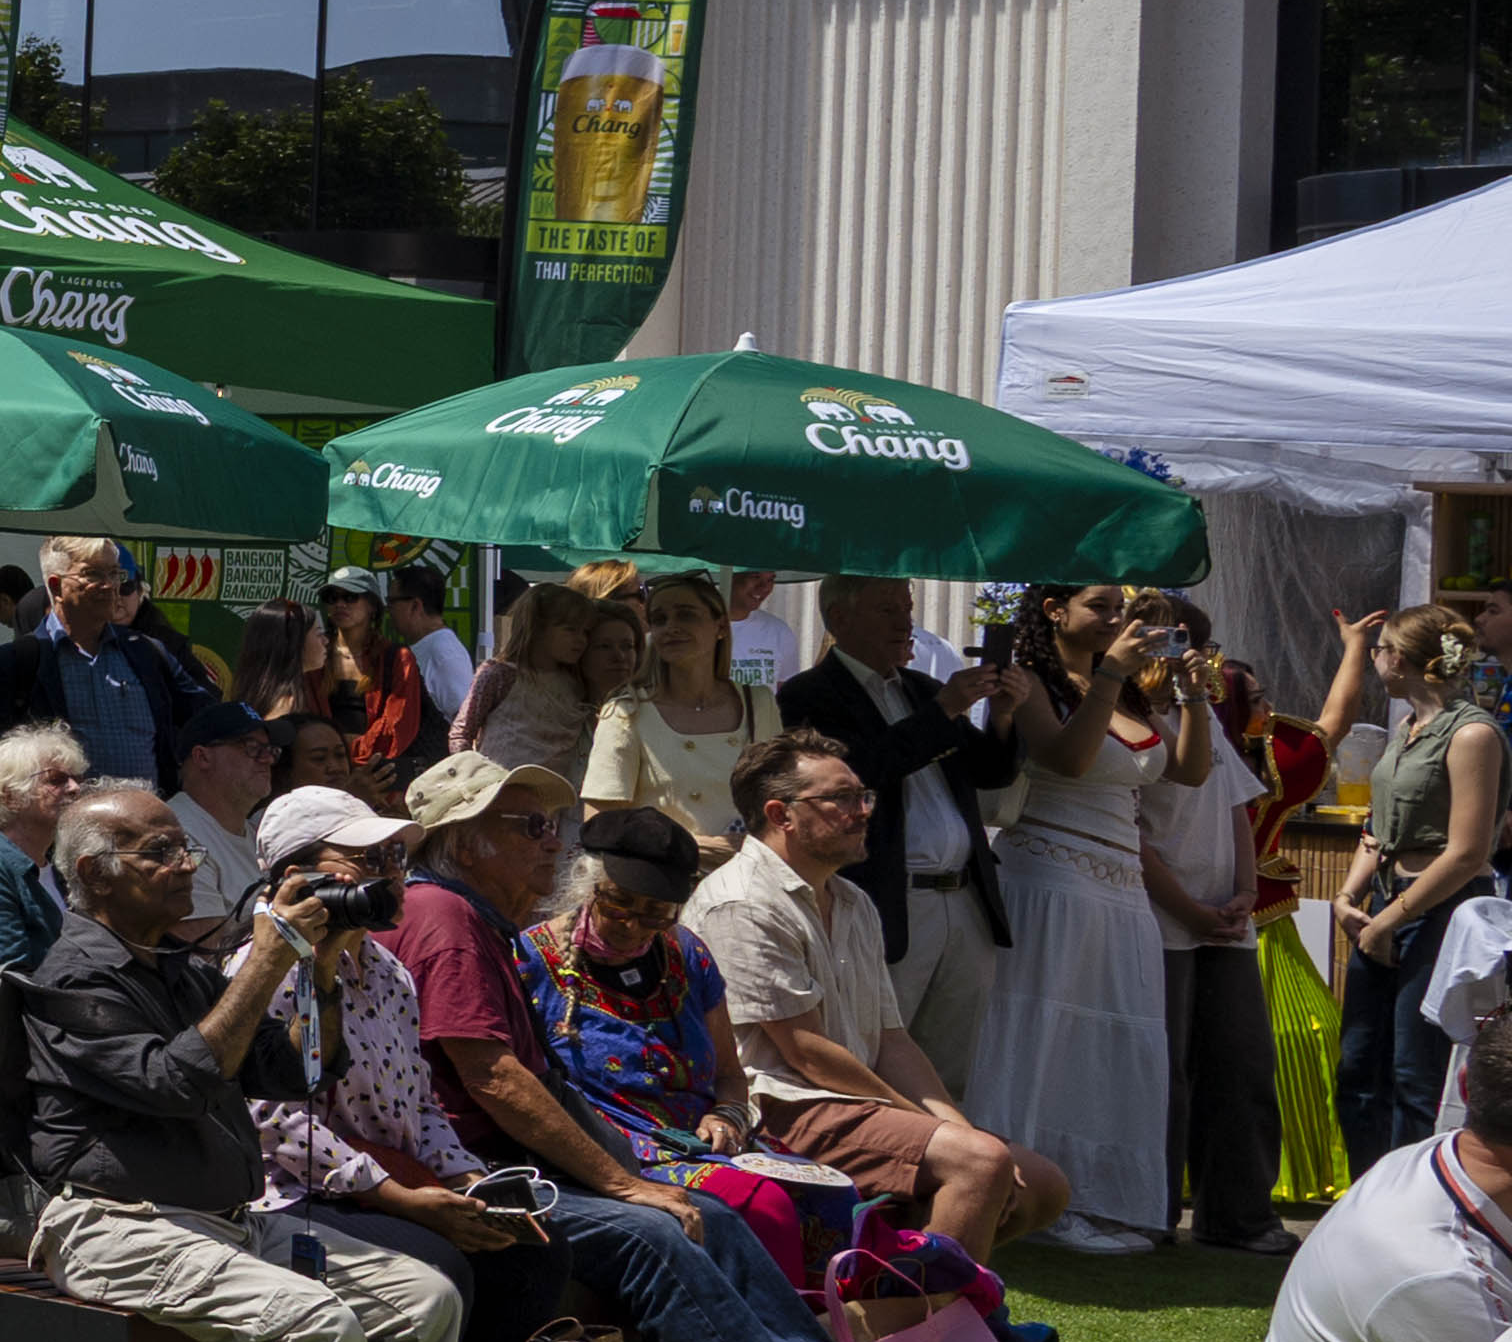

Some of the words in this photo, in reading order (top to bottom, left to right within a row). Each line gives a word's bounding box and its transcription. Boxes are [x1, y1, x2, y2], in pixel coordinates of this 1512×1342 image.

[572, 114, 641, 139] Chang
[39, 195, 99, 209] LAGER
[106, 202, 158, 218] BEER
[538, 227, 570, 249] THE
[576, 228, 629, 252] TASTE
[634, 231, 657, 254] OF
[60, 275, 95, 287] LAGER
[96, 278, 124, 289] BEER
[534, 261, 567, 280] THAI
[569, 263, 654, 284] PERFECTION
[0, 266, 137, 347] Chang
[486, 406, 608, 445] Chang
[805, 423, 971, 470] Chang
[370, 462, 443, 498] Chang
[726, 488, 805, 528] Chang
[226, 551, 281, 567] BANGKOK
[226, 567, 281, 583] BANGKOK
[224, 583, 281, 599] BANGKOK
